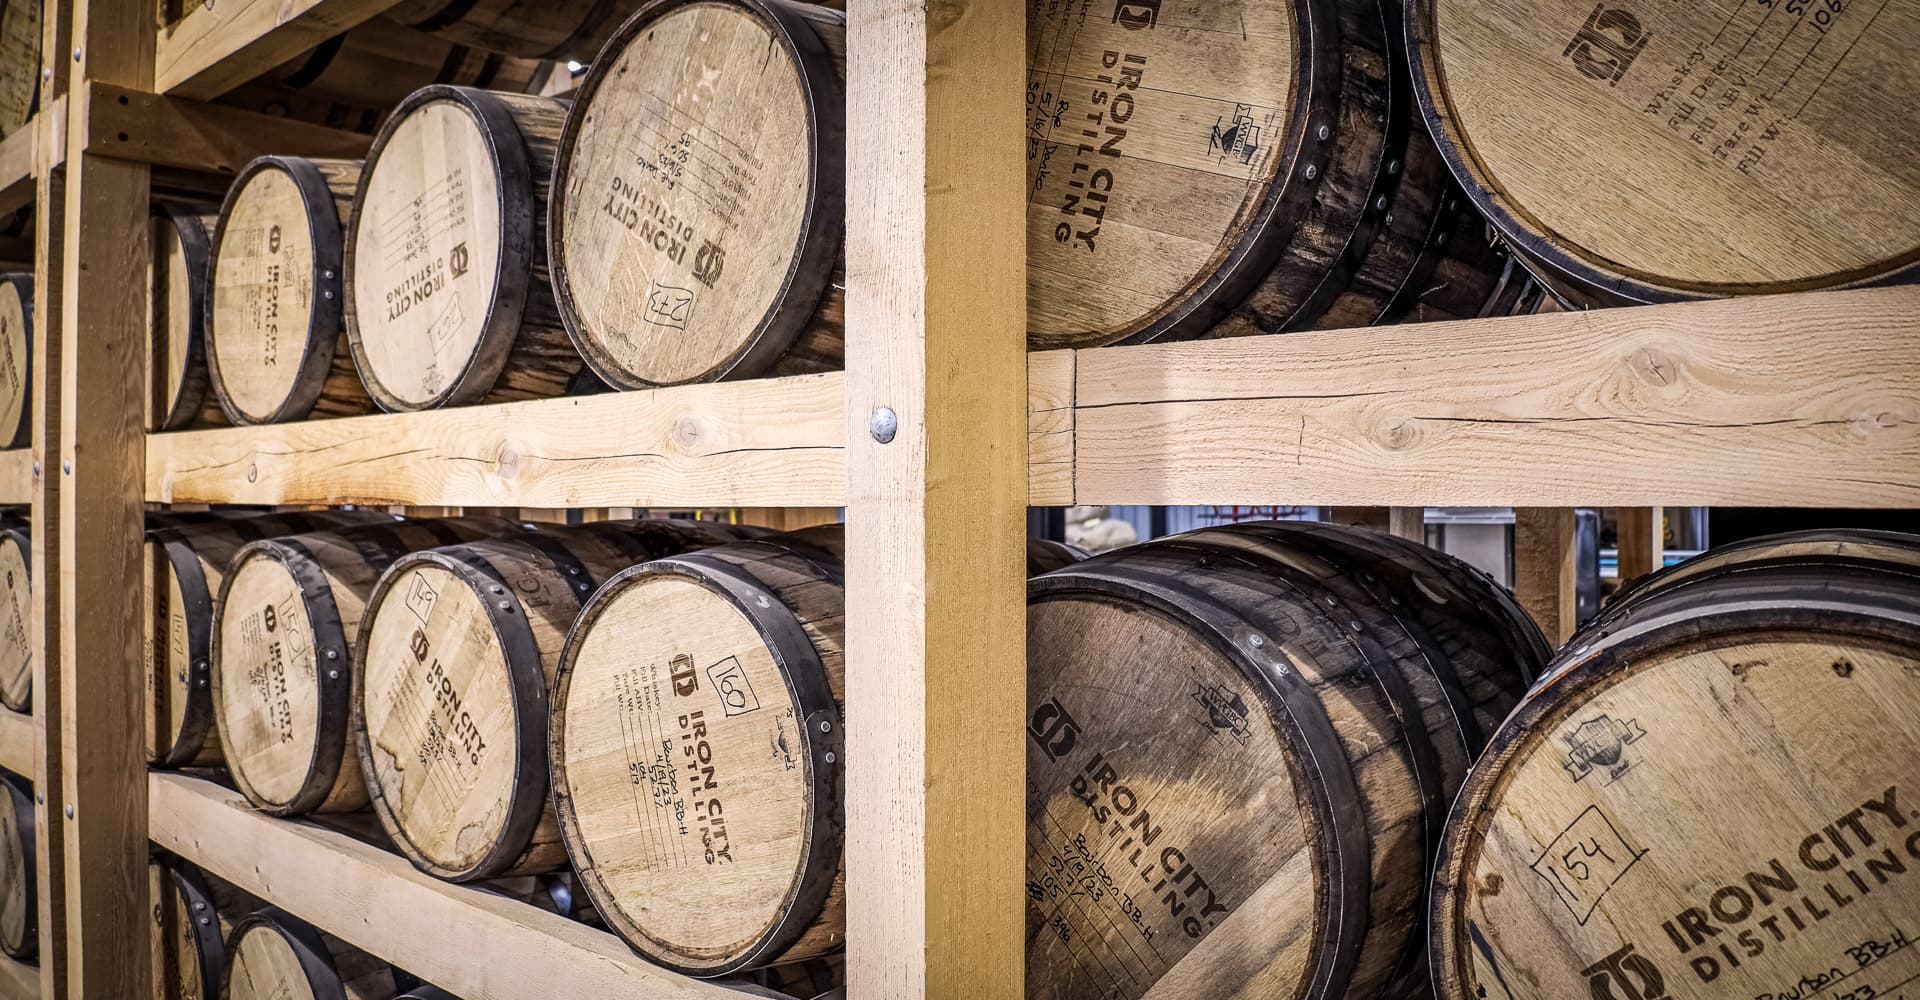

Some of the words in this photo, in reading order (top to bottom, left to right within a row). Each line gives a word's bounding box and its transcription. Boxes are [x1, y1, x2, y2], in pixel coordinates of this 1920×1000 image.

[1100, 52, 1147, 159] IRON
[1054, 50, 1119, 244] DISTILLING
[1712, 121, 1750, 160] Tare
[1736, 145, 1766, 176] Fill
[611, 177, 694, 242] DISTILLING
[640, 219, 687, 266] IRON
[271, 265, 280, 318] IRON
[386, 257, 443, 304] DISTILLING
[414, 272, 445, 306] IRON
[651, 291, 690, 321] 273
[274, 641, 287, 694] IRON
[432, 658, 461, 712] IRON
[715, 667, 746, 708] 160
[426, 672, 478, 765] DISTILLING
[691, 711, 718, 789] IRON
[678, 715, 715, 865] DISTILLING
[1085, 752, 1163, 847] IRON
[1070, 774, 1202, 938] DISTILLING
[1549, 835, 1616, 901] 154
[1040, 871, 1064, 898] 105
[1661, 858, 1799, 954] IRON
[1844, 927, 1911, 967] BB-H
